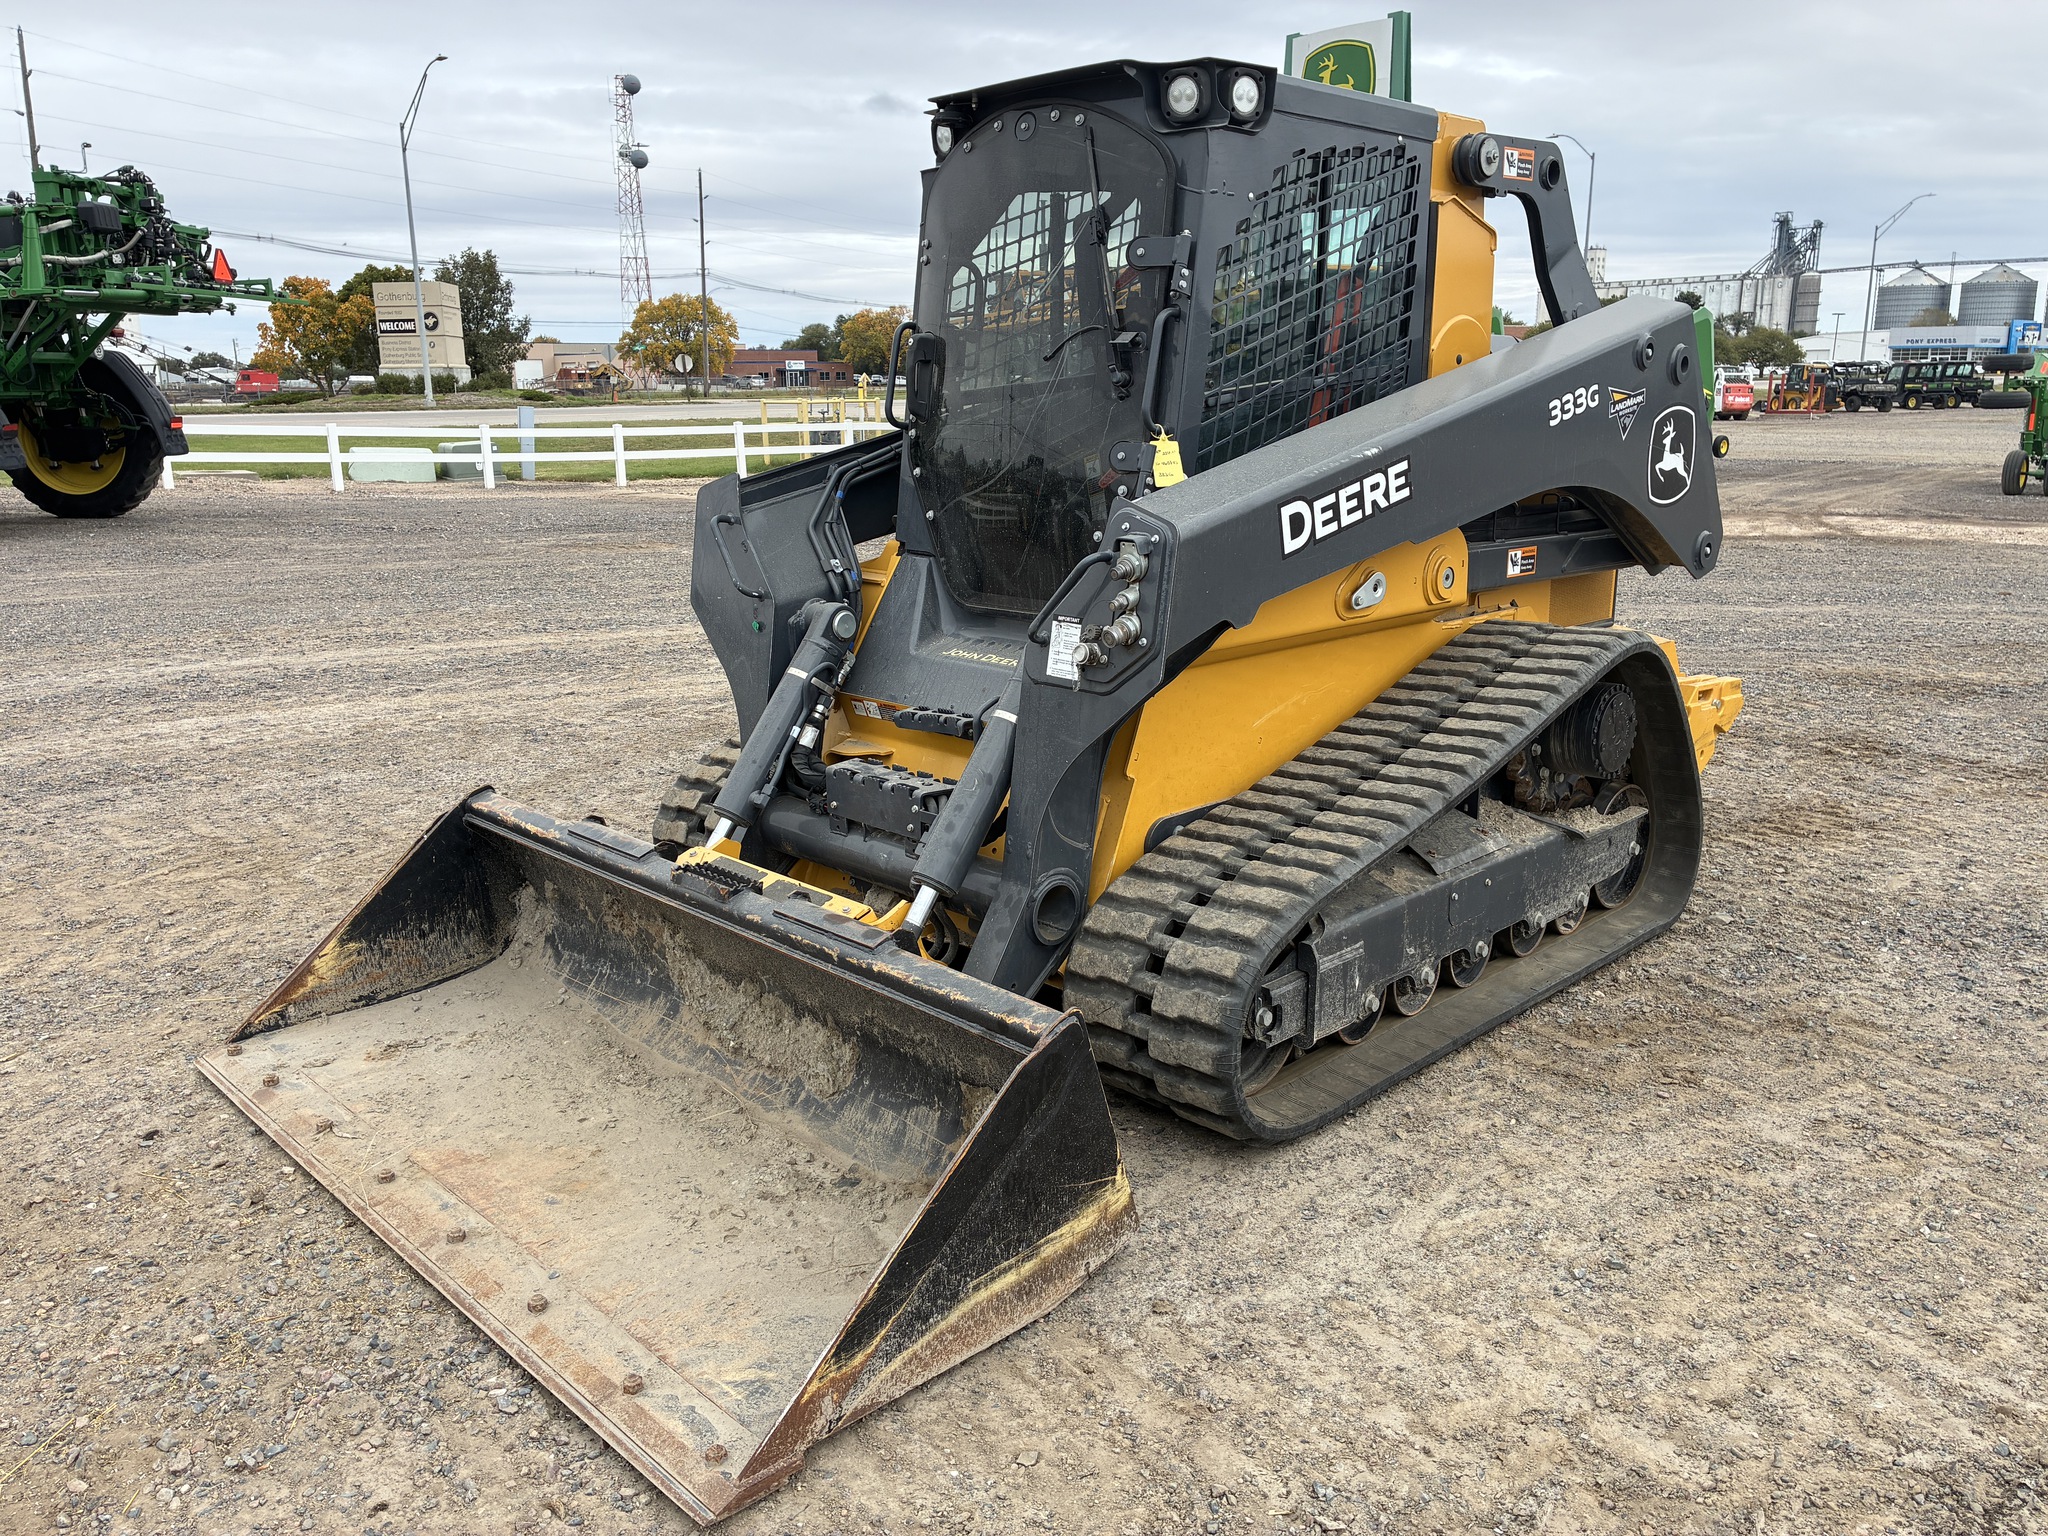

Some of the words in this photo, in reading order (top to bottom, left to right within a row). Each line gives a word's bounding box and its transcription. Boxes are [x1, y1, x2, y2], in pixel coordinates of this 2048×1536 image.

[376, 292, 426, 302] Gothenbug
[380, 322, 416, 331] WELCOME
[1548, 384, 1599, 427] 333G
[1280, 459, 1411, 555] DEERE
[1057, 615, 1081, 623] IMPORTANT
[942, 648, 983, 660] JOHN
[980, 654, 1019, 667] DEER
